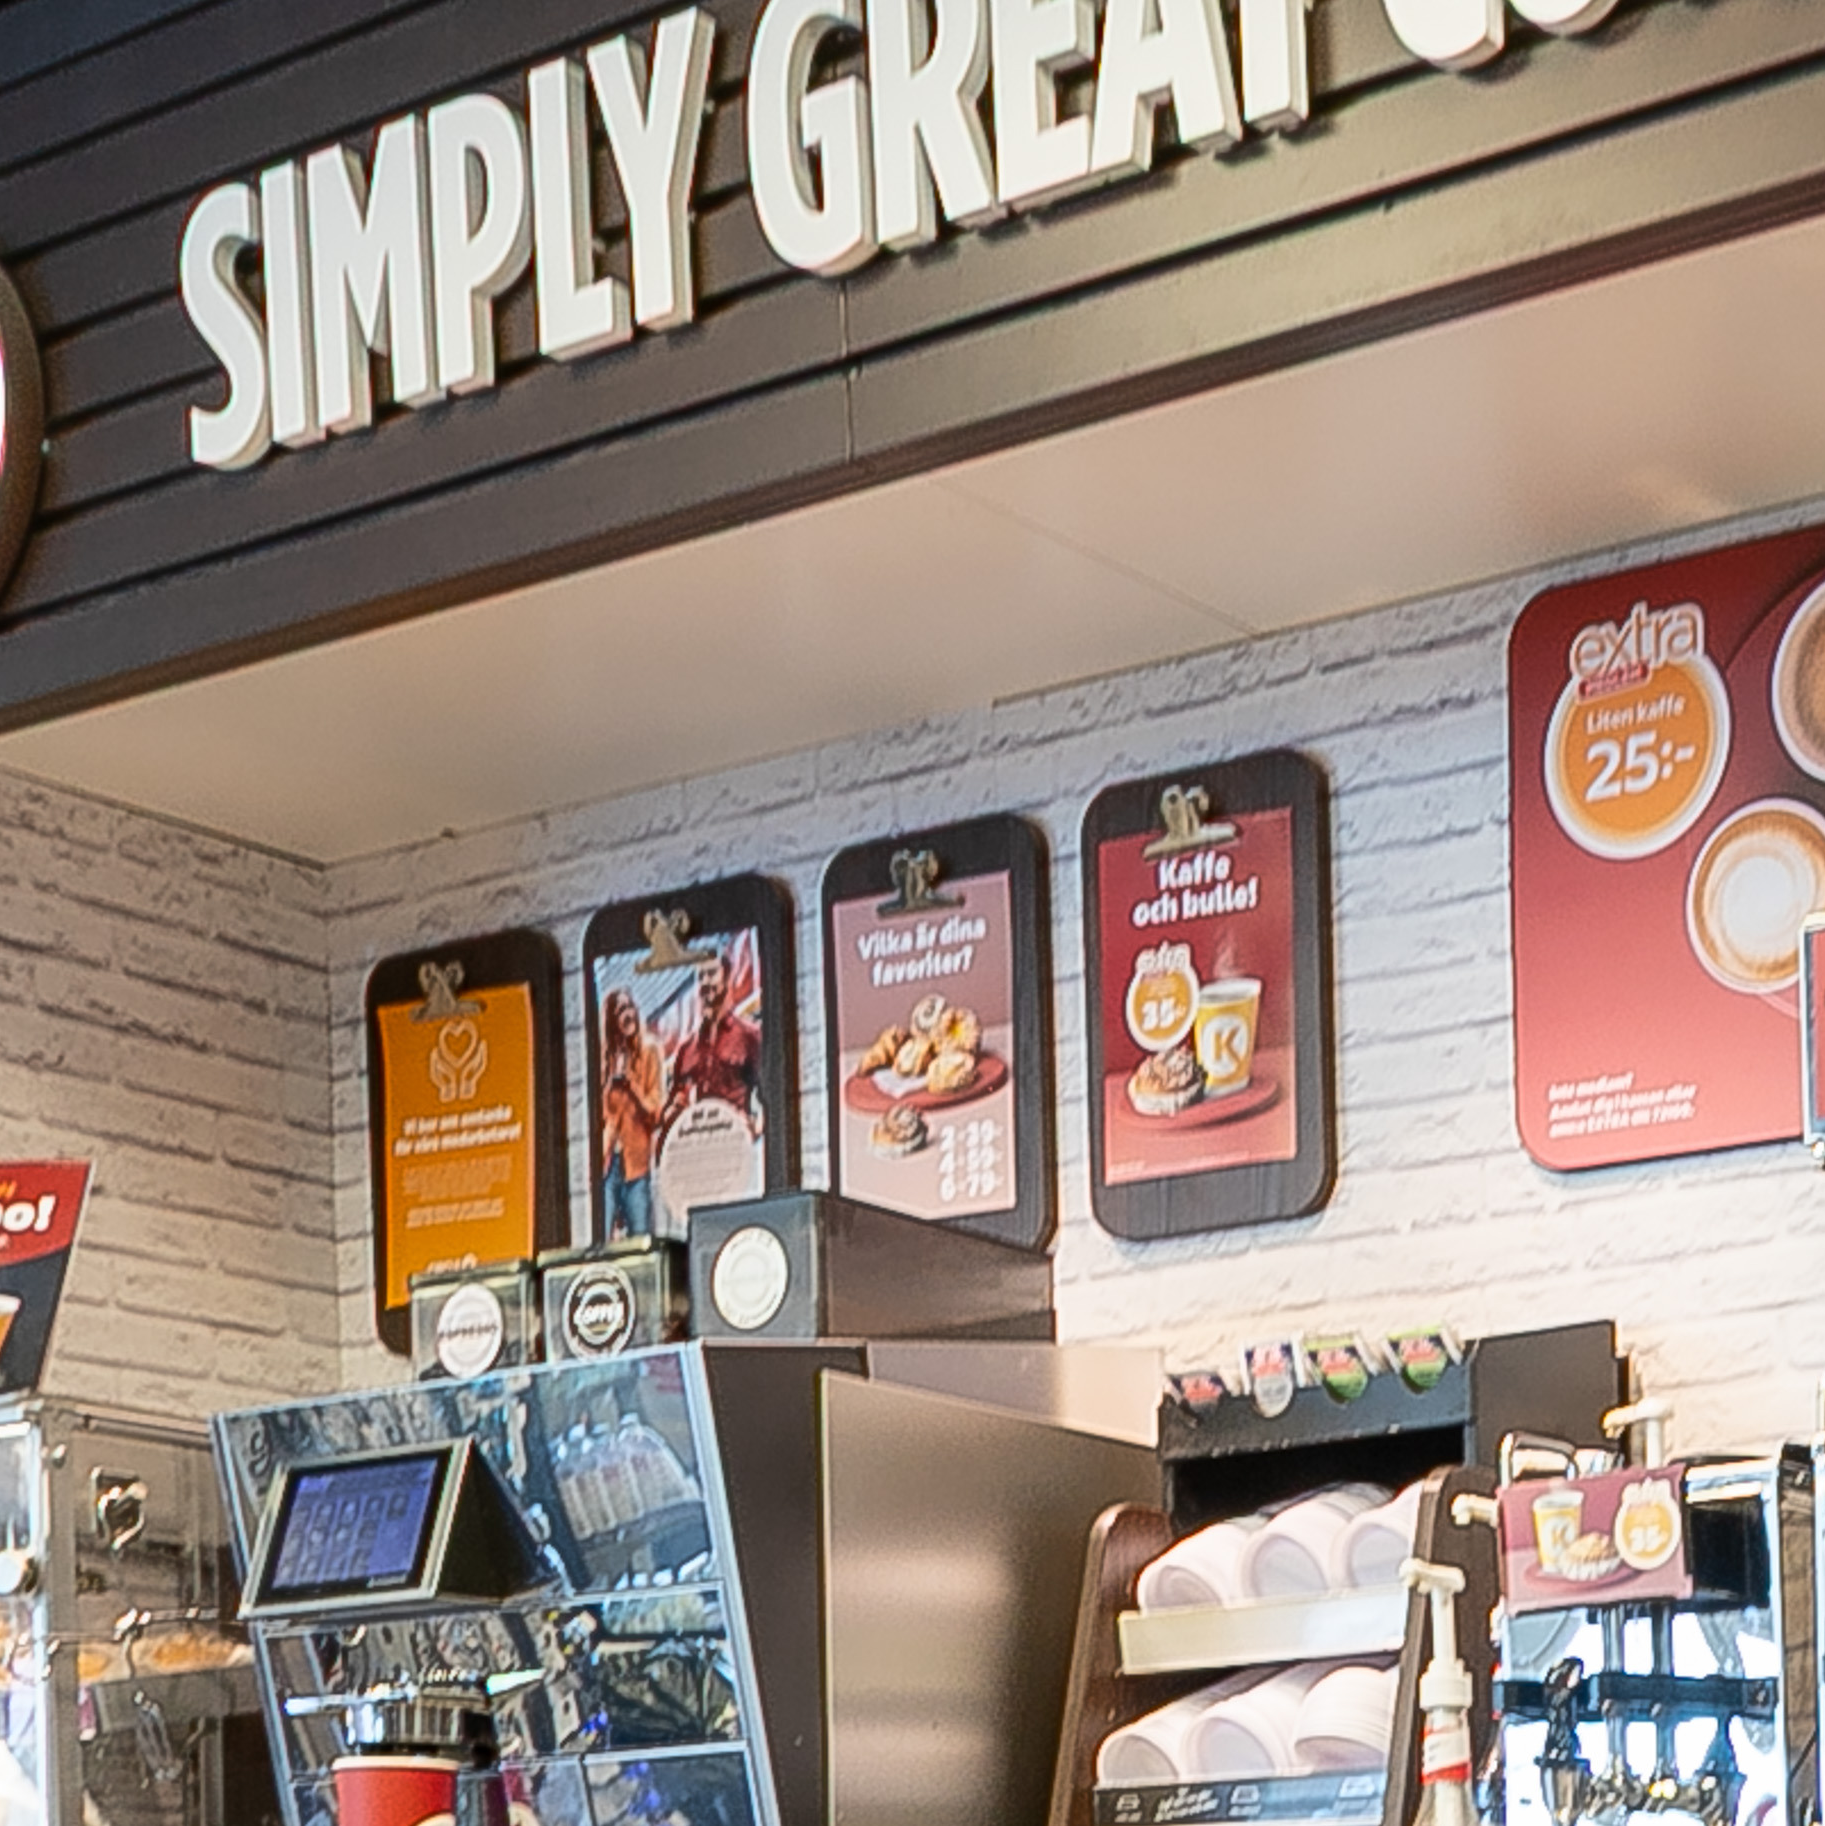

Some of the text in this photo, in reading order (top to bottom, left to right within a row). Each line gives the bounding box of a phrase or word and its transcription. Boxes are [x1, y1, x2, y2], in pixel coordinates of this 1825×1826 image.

[178, 6, 715, 470] SIMPLY
[1570, 600, 1704, 677] extra
[1586, 693, 1685, 735] Liten kaffe
[1585, 729, 1696, 803] 25:-
[1159, 850, 1231, 890] Kaffe
[1132, 876, 1259, 928] och bulle!
[858, 914, 987, 961] Vilka är dina
[872, 944, 973, 988] favoriter?
